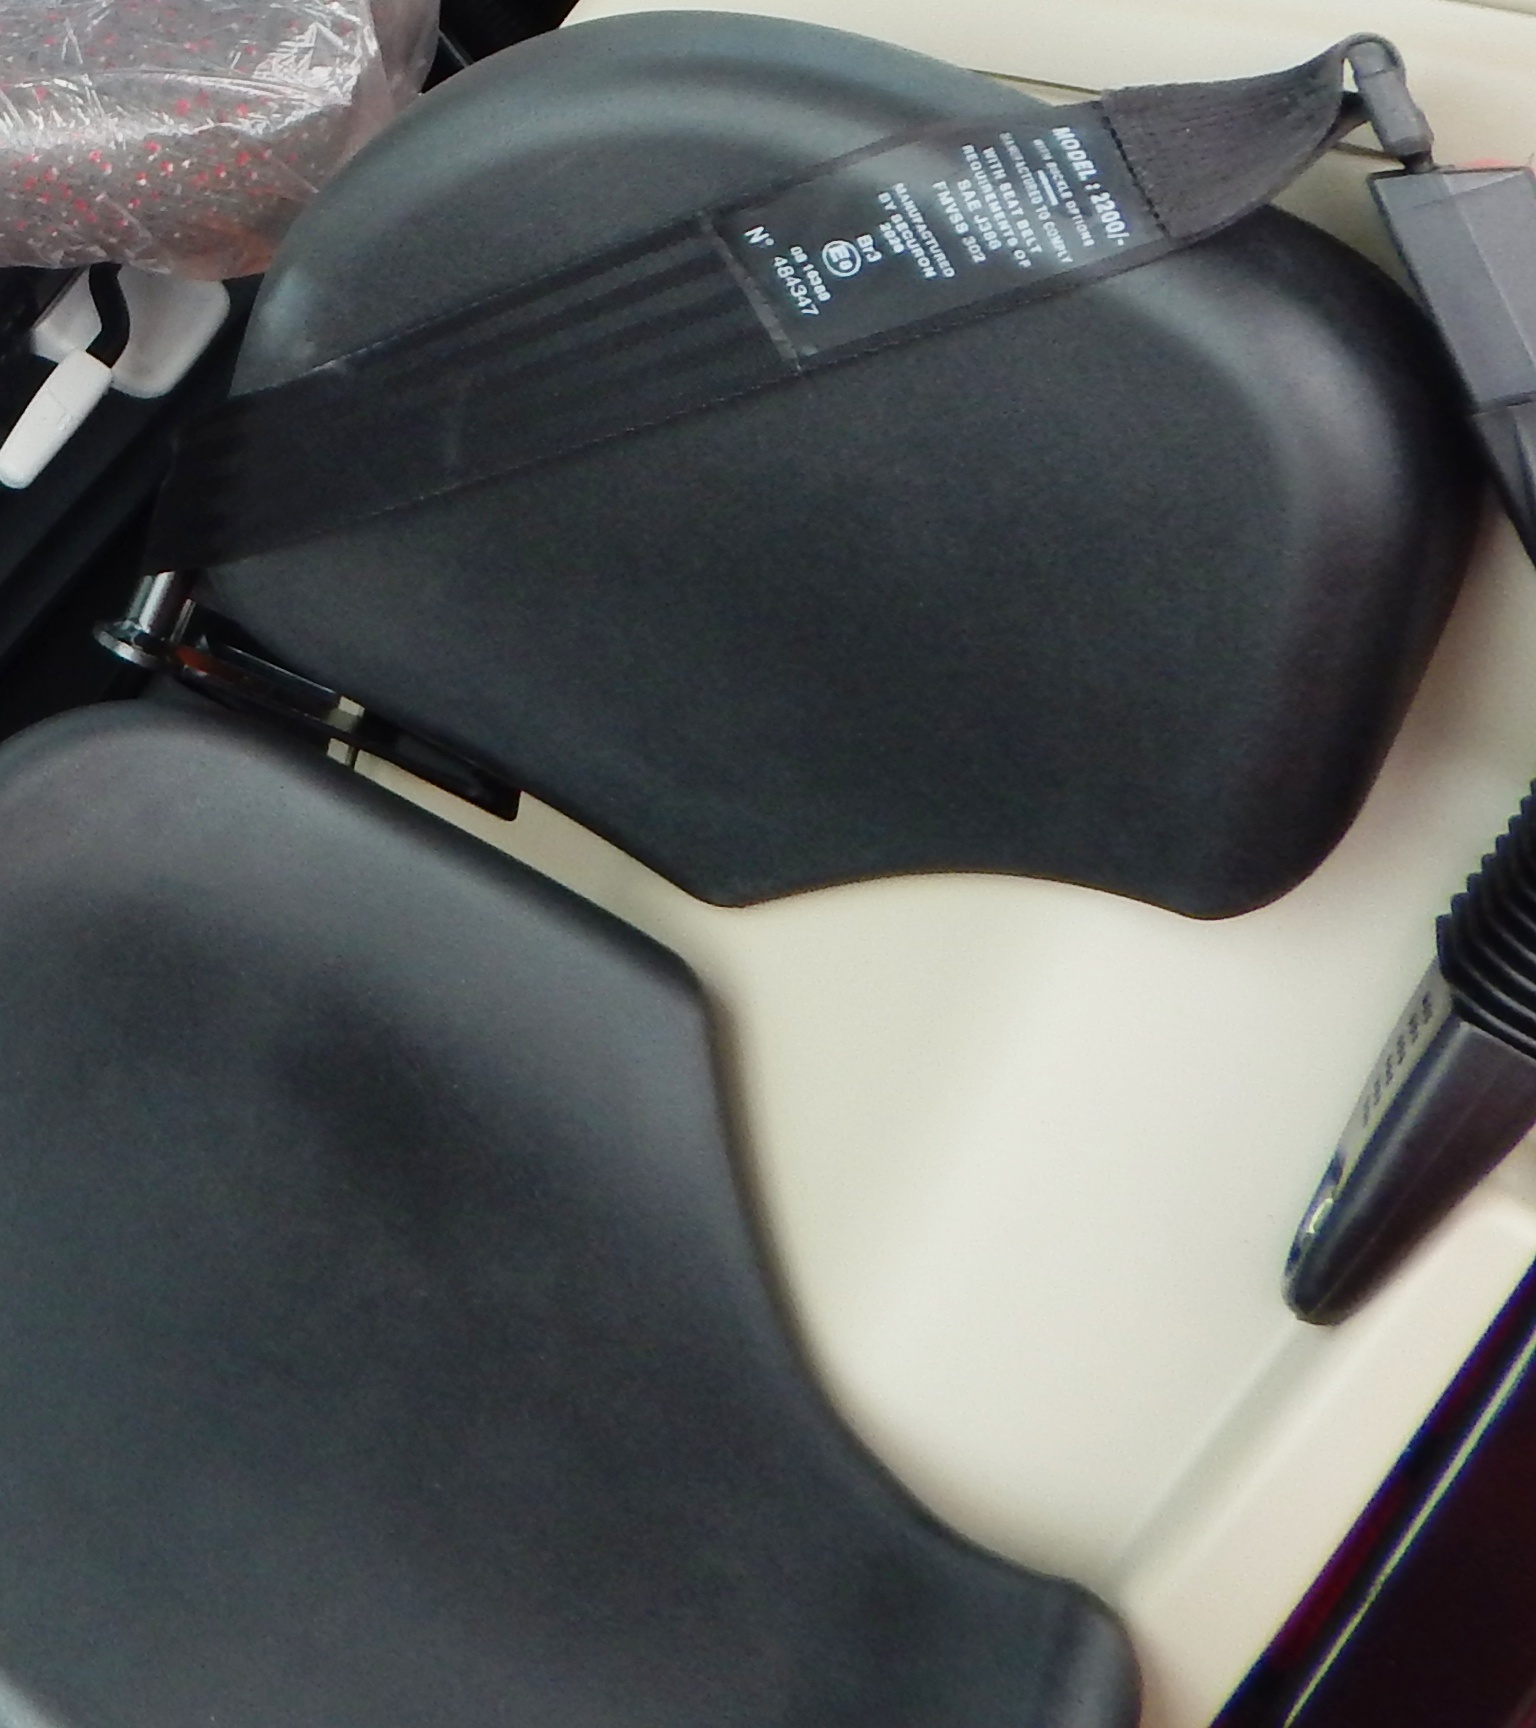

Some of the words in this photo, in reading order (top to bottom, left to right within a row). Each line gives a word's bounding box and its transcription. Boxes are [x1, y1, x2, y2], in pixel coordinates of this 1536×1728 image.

[998, 131, 1044, 205] MANUFACTURED
[1052, 126, 1098, 182] MODEL
[893, 182, 955, 279] MANUFACTURED
[932, 180, 969, 235] FMVSS
[962, 235, 987, 264] 302
[957, 178, 982, 213] SAE
[961, 143, 1020, 247] REQUIREMENTS
[1013, 249, 1032, 268] OF
[982, 146, 1007, 180] WITH
[999, 182, 1025, 216] SEAT
[1016, 219, 1043, 254] BELT
[1035, 205, 1052, 221] TO
[1045, 161, 1074, 199] BUCKLE
[1065, 200, 1096, 247] OPTIONS
[856, 234, 882, 263] Br3
[878, 192, 897, 211] BY
[890, 214, 938, 279] SECURON
[1043, 221, 1074, 264] COMPLY
[774, 256, 819, 316] 484347
